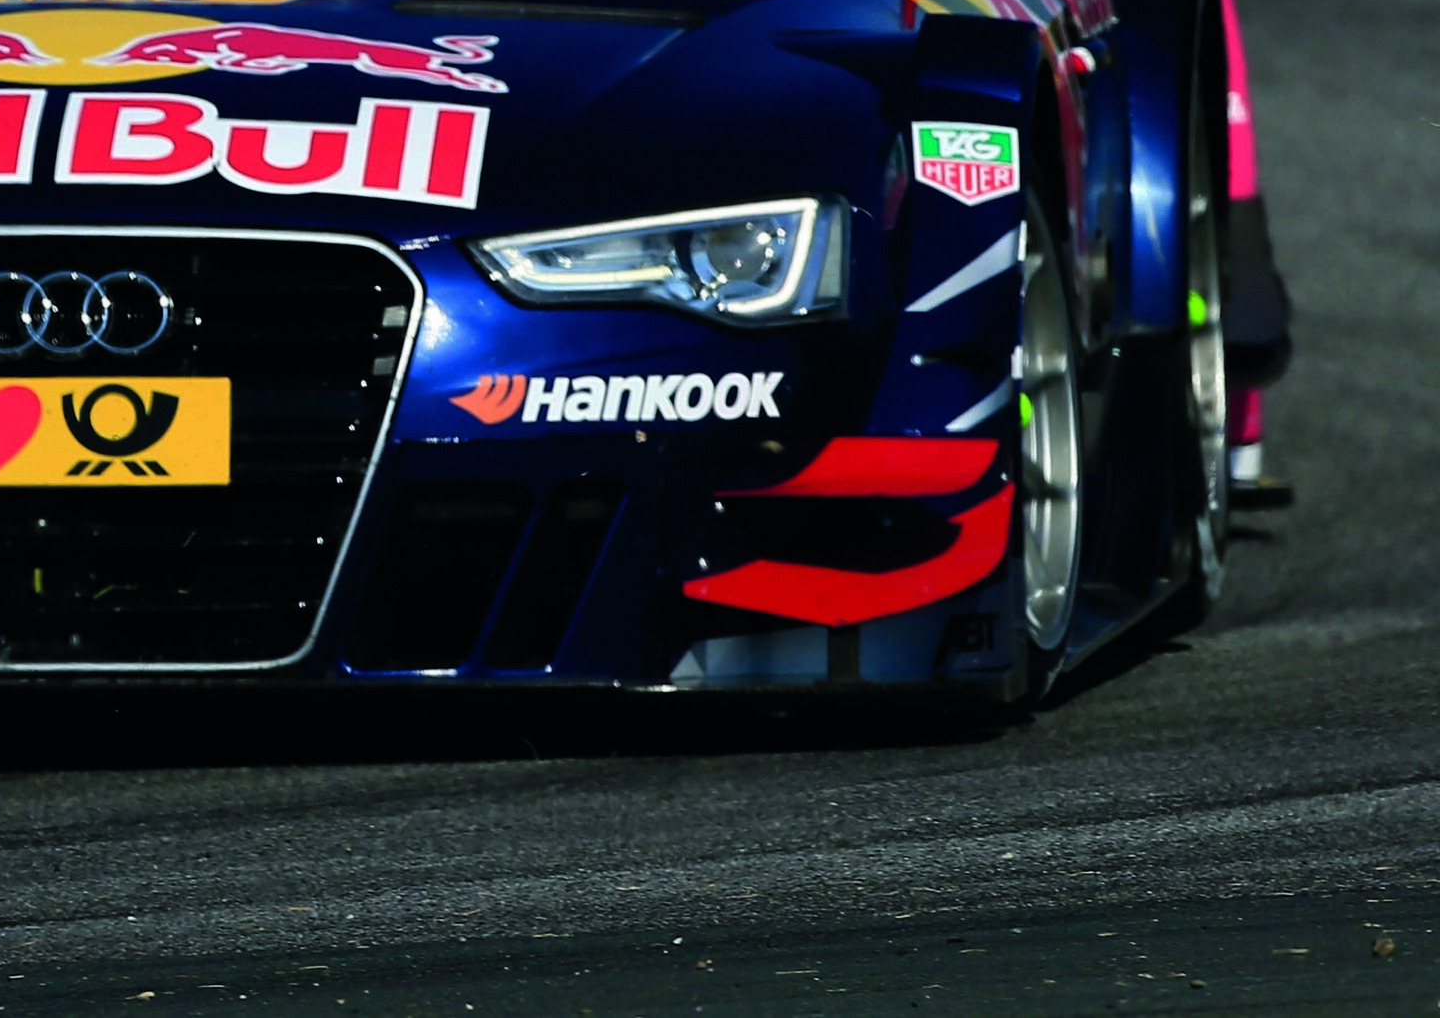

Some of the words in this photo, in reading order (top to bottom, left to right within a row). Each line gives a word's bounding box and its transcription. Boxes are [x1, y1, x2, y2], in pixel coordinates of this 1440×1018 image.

[69, 96, 477, 200] Bull
[931, 130, 1002, 161] TAG
[924, 162, 1012, 195] HEUER
